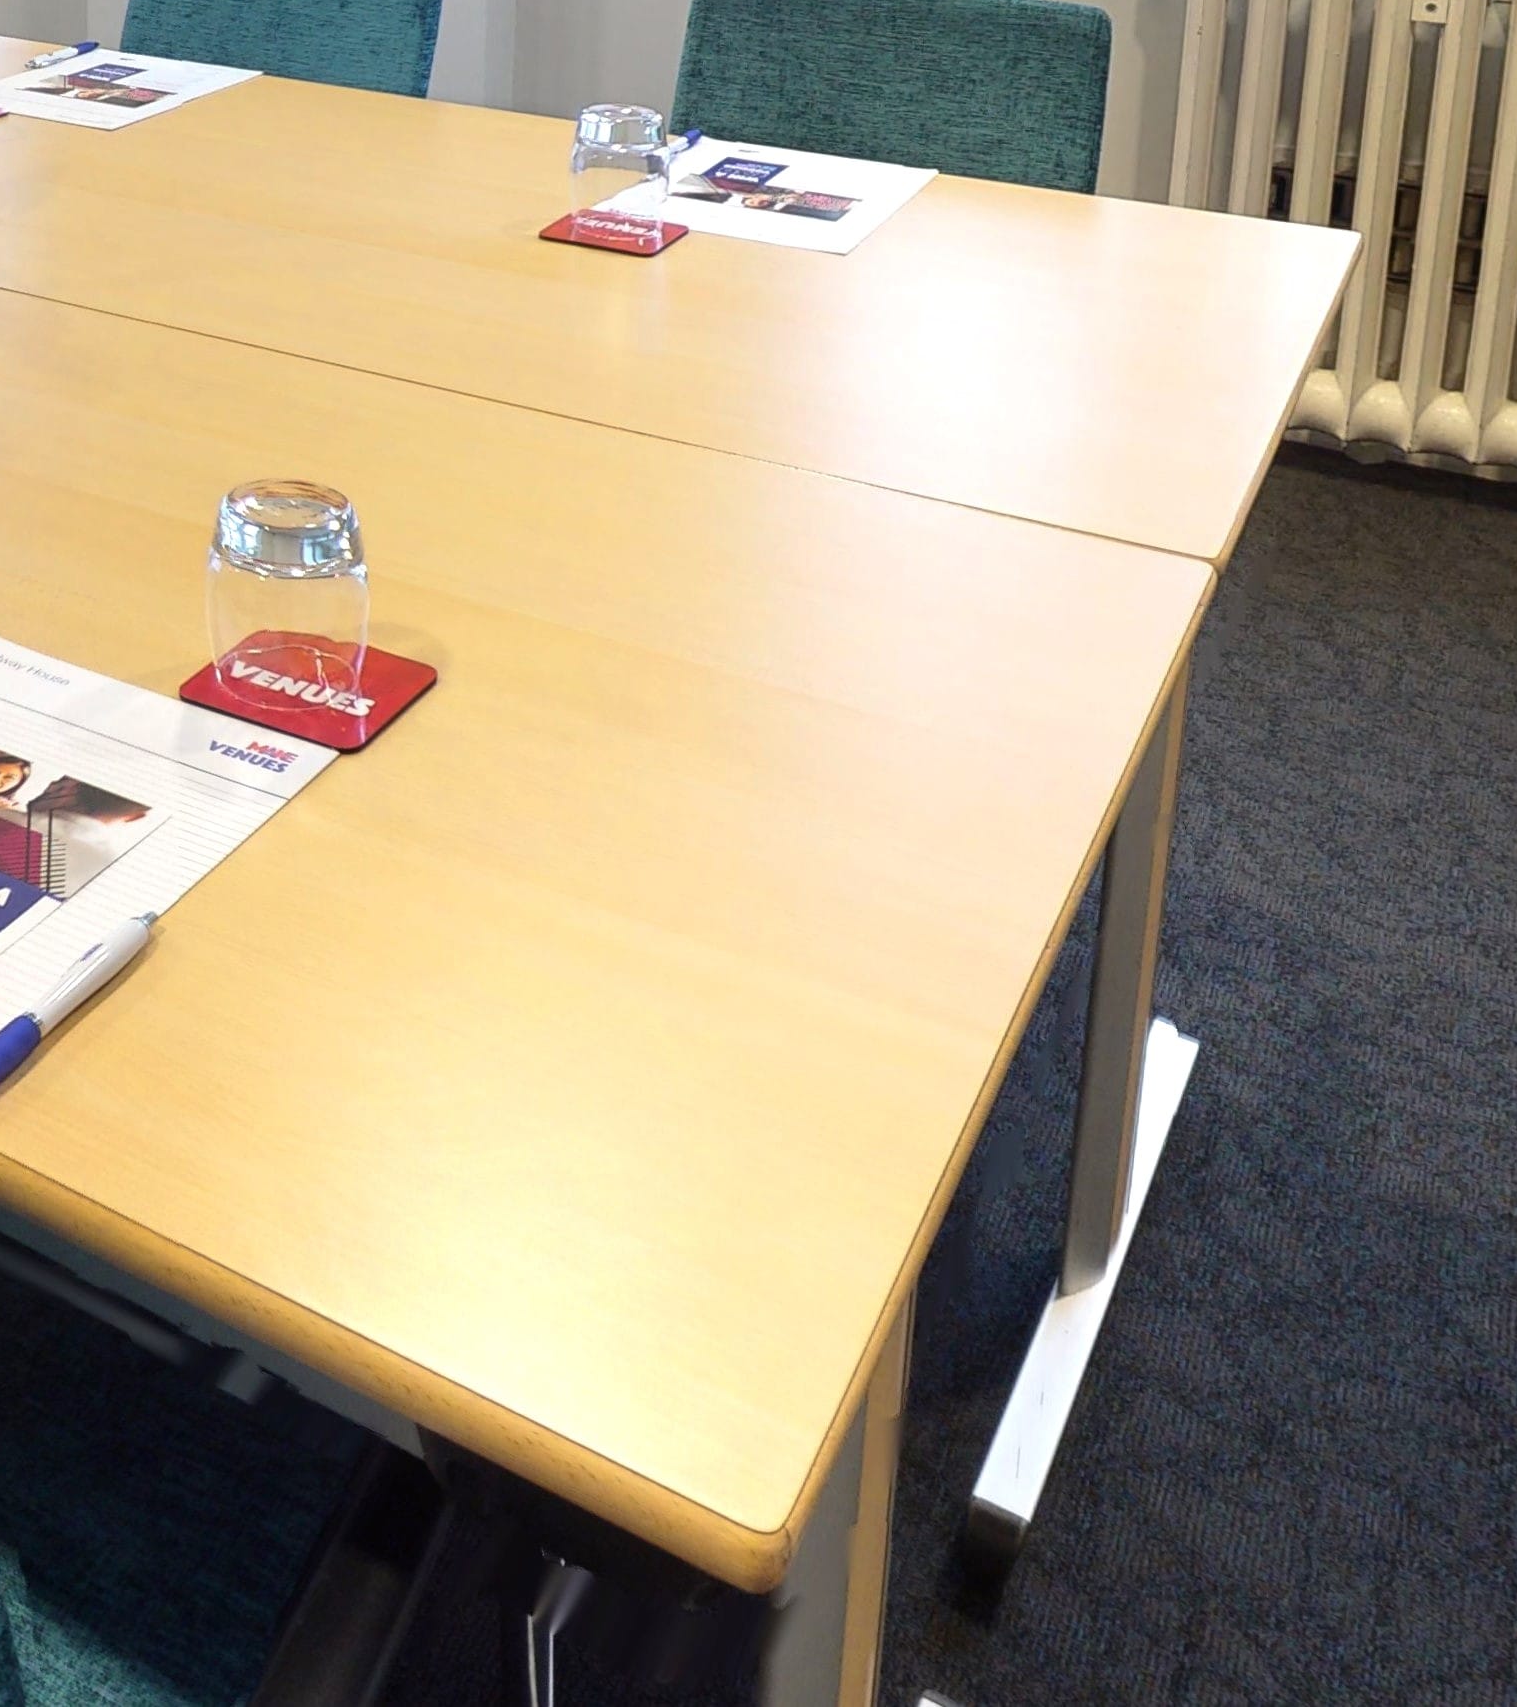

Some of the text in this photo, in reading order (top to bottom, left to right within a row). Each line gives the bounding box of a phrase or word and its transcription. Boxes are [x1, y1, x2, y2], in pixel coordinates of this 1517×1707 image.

[27, 665, 72, 687] House
[228, 659, 377, 718] VENUES
[209, 740, 288, 773] VENUES
